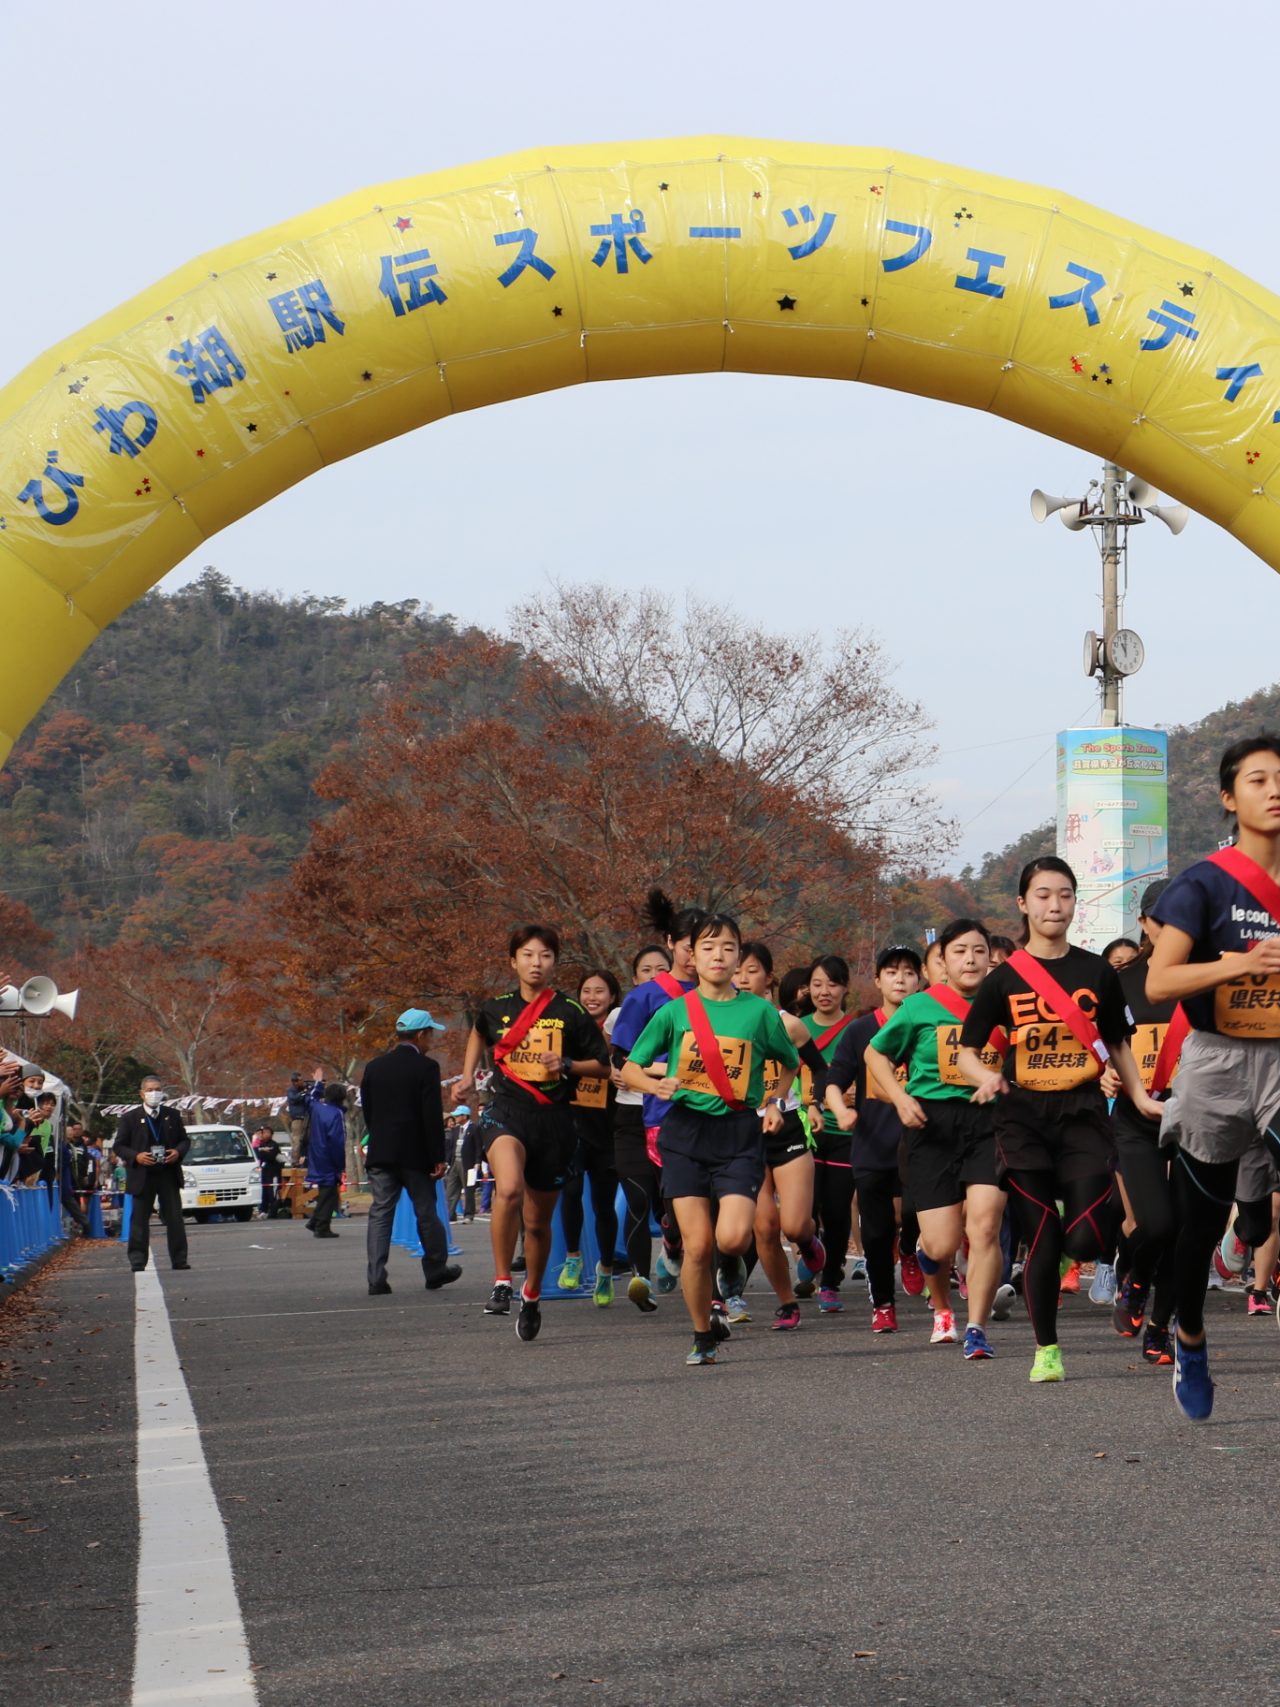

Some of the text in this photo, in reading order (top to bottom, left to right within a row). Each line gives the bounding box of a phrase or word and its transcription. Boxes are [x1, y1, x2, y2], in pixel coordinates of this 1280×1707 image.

[1081, 743, 1157, 754] The Sports Zone
[1025, 1025, 1089, 1052] 64-
[689, 1040, 746, 1066] 4-1
[1026, 1052, 1089, 1070] 県民共済
